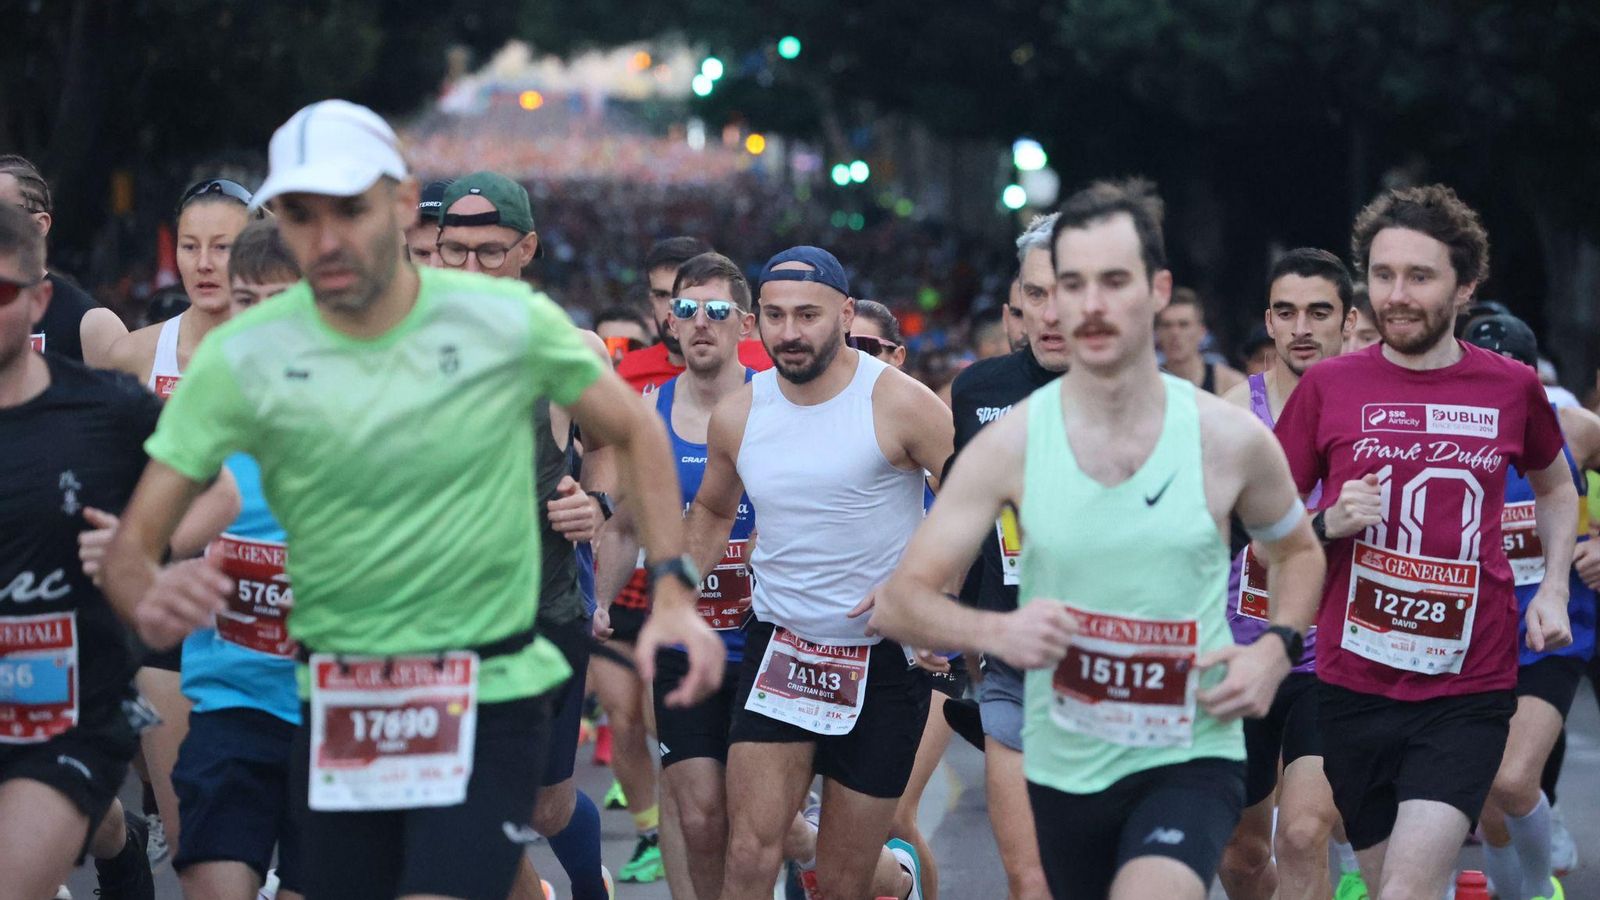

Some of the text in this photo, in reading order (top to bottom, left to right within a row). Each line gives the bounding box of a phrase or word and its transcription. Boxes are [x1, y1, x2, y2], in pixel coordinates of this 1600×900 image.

[1388, 410, 1406, 418] sse
[1388, 417, 1420, 427] Airtricity
[1432, 409, 1494, 425] DUBLIN
[1352, 437, 1422, 462] Frank
[1385, 556, 1470, 585] GENERALI
[1374, 588, 1447, 624] 12728
[1089, 617, 1192, 643] GENERALI
[1391, 617, 1418, 630] DAVID
[1426, 646, 1447, 656] 21K
[787, 662, 841, 691] 14143
[1079, 653, 1166, 690] 15112
[787, 681, 819, 696] CRISTIAN
